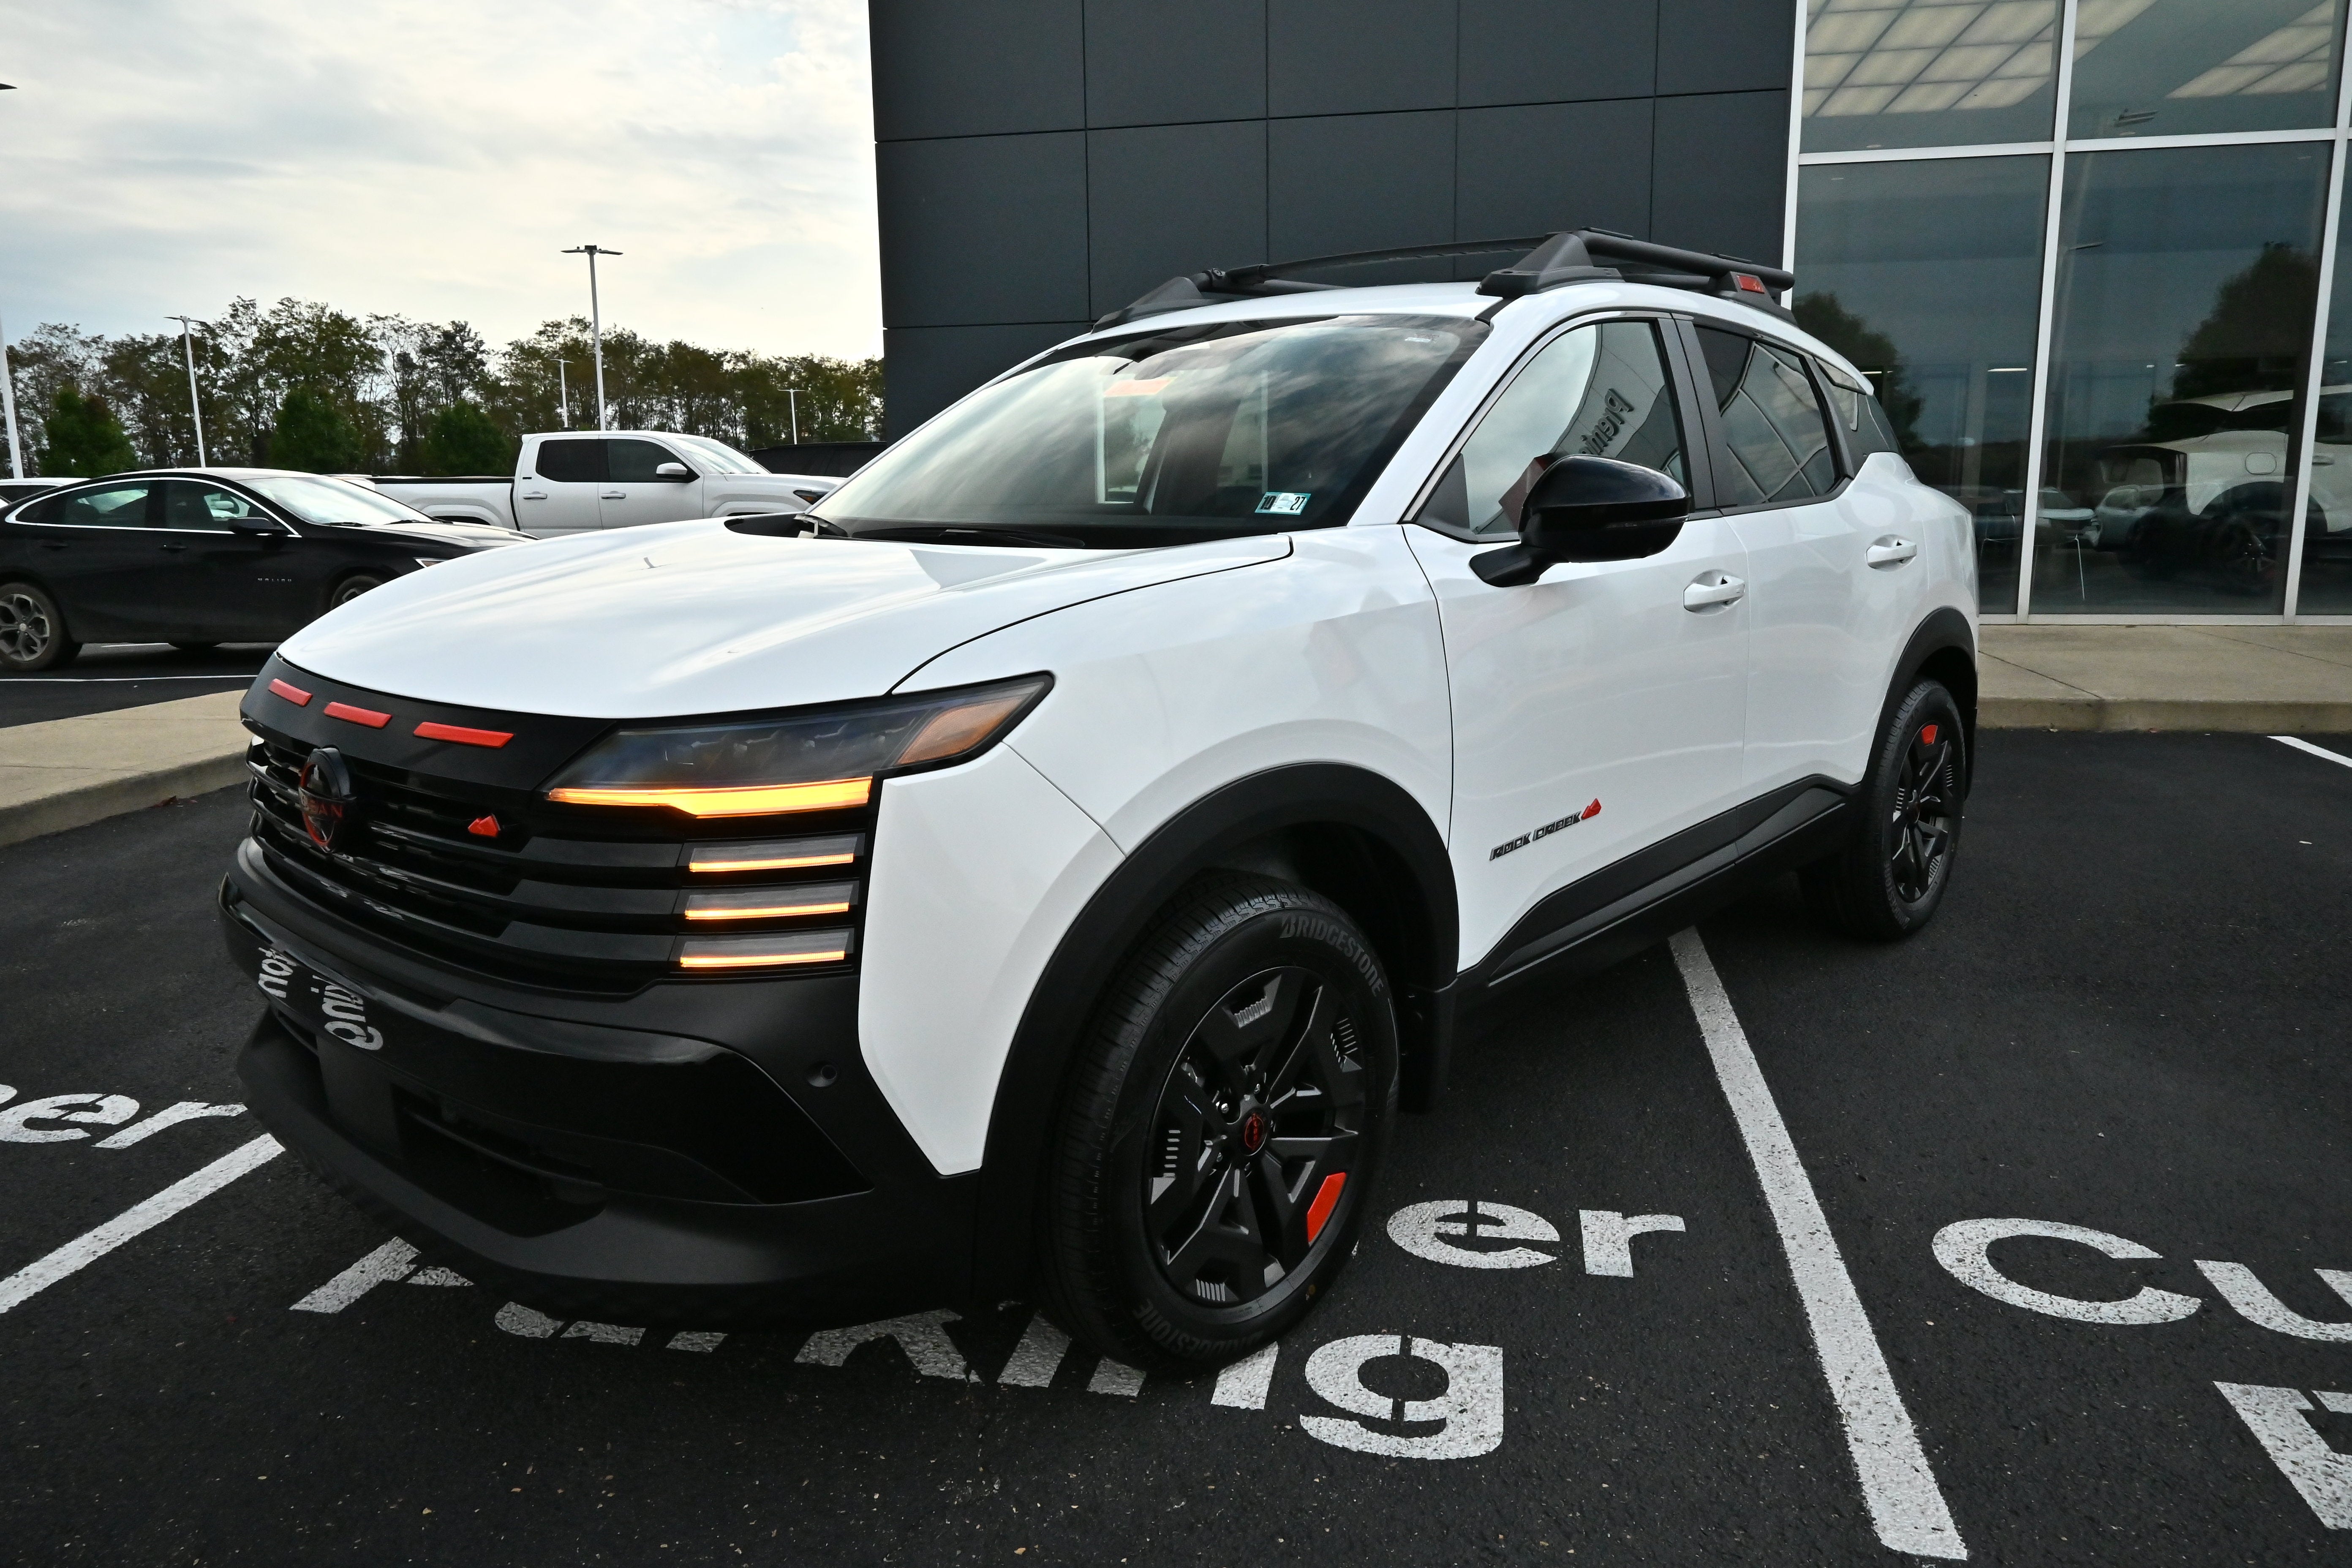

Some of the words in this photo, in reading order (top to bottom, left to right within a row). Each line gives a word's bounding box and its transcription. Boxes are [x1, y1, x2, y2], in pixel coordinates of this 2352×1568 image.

[1290, 496, 1307, 511] 27
[1489, 832, 1532, 861] ROCK
[1532, 811, 1582, 841] CREEK
[1279, 914, 1385, 997] BRIDGESTONE
